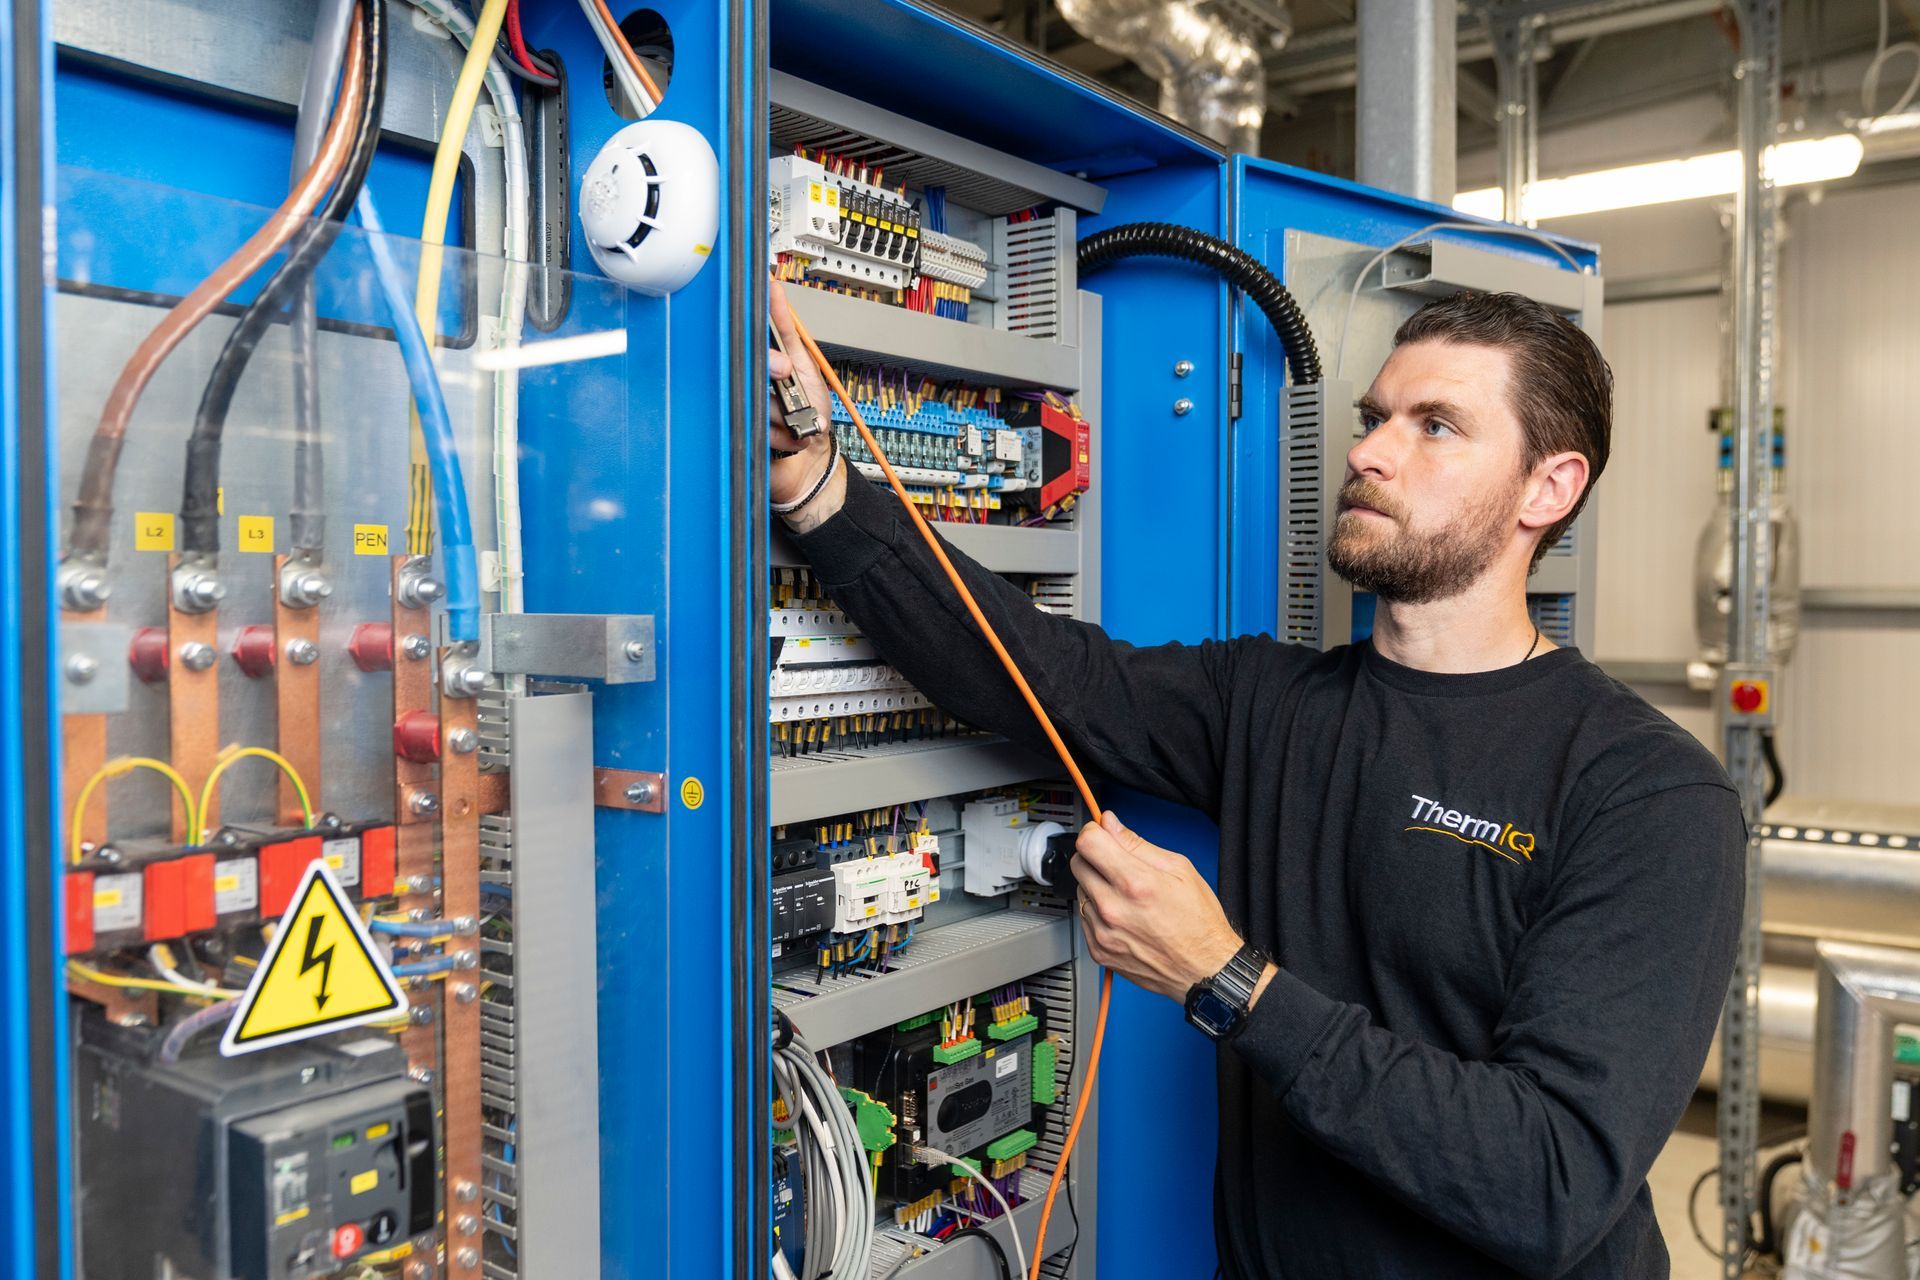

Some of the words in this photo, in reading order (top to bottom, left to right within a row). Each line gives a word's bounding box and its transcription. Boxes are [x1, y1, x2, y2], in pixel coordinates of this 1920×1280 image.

[145, 526, 164, 538] L2
[248, 528, 265, 540] L3
[355, 532, 388, 548] PEN
[1411, 794, 1535, 861] ThermIQ
